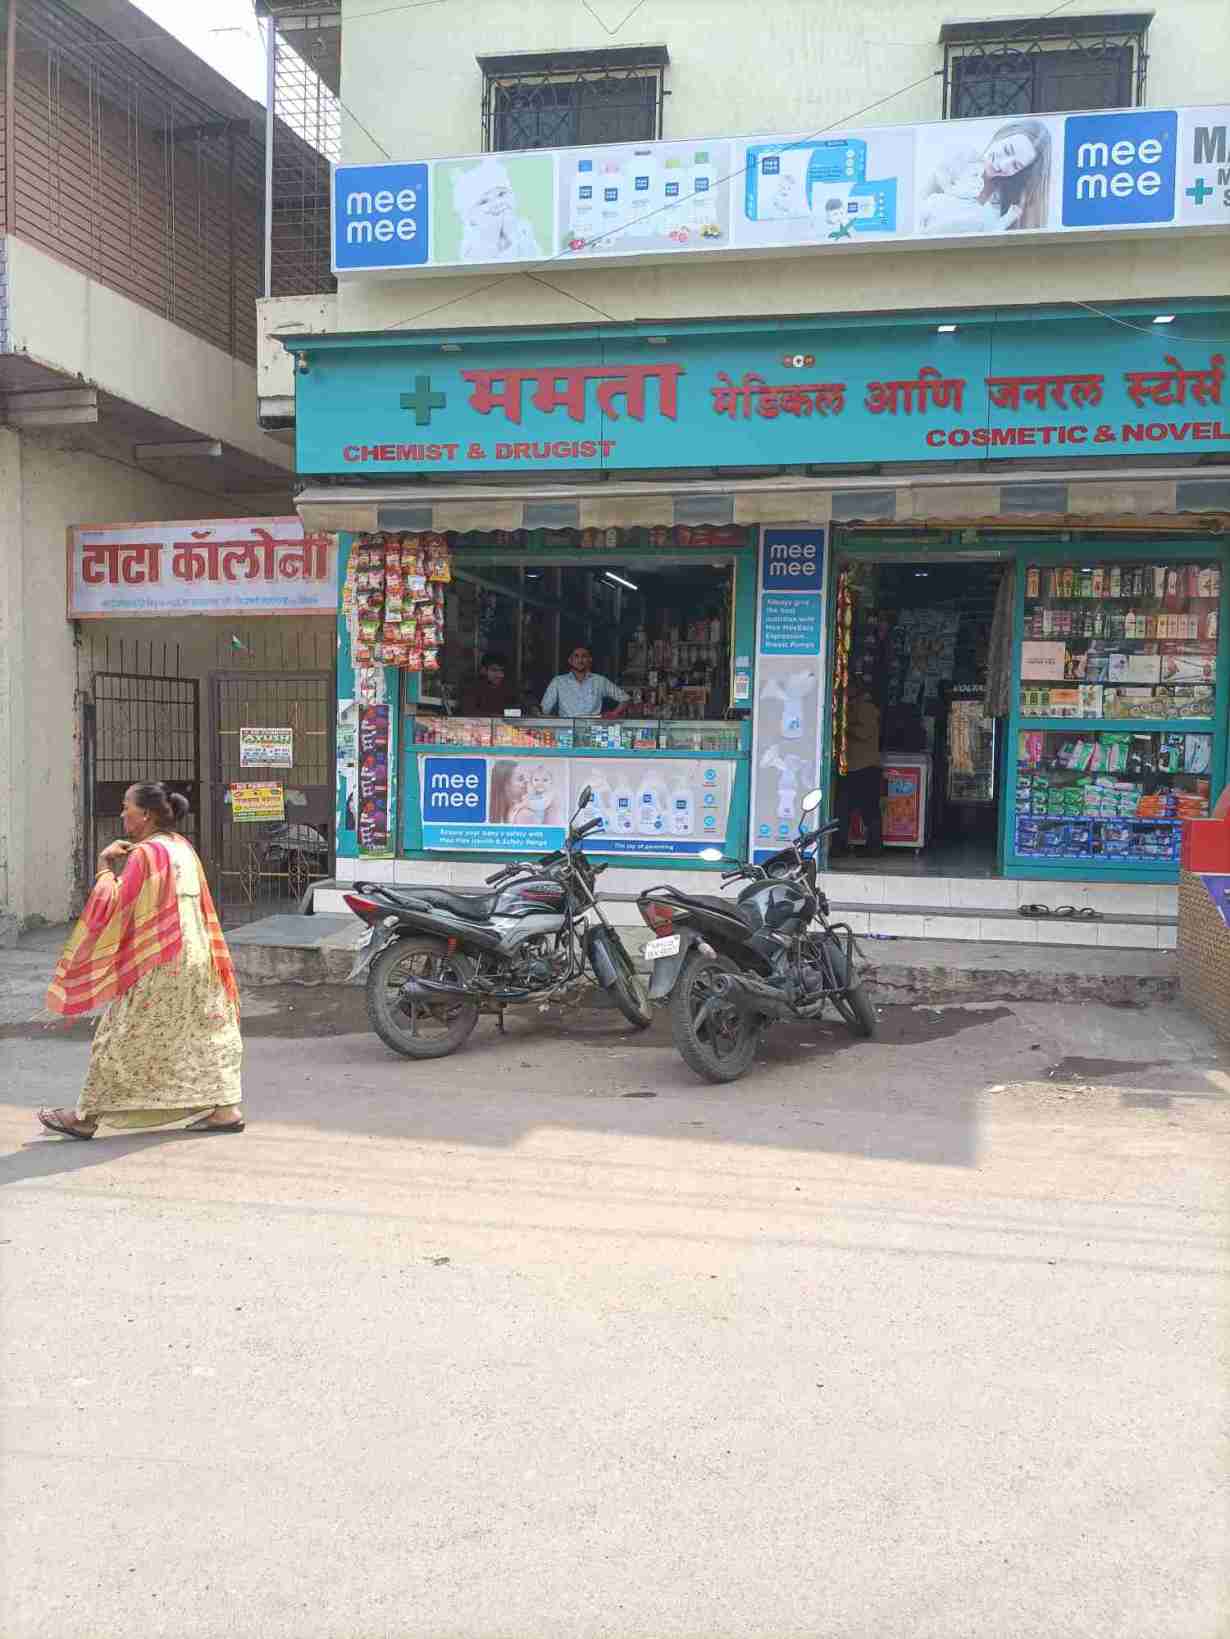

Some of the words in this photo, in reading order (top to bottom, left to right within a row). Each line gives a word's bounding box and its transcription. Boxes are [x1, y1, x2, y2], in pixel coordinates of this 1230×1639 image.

[1077, 137, 1163, 168] mee
[1193, 126, 1230, 164] M
[1076, 167, 1162, 200] mee
[347, 188, 417, 215] mee
[347, 216, 417, 244] mee
[459, 362, 687, 425] ममता
[711, 371, 848, 420] मेडिकल
[864, 366, 966, 417] आणि
[985, 373, 1104, 412] जनरल
[1121, 352, 1225, 409] स्टोर्स
[925, 426, 1087, 447] COSMETIC
[1094, 426, 1120, 442] &
[1122, 421, 1230, 441] NOVEL
[342, 443, 459, 462] CHEMIST
[467, 442, 486, 459] &
[495, 440, 616, 460] DRUGIST
[82, 542, 163, 584] टाटा
[770, 544, 816, 559] mee
[768, 561, 816, 576] mee
[431, 773, 478, 789] mee
[431, 791, 478, 807] mee
